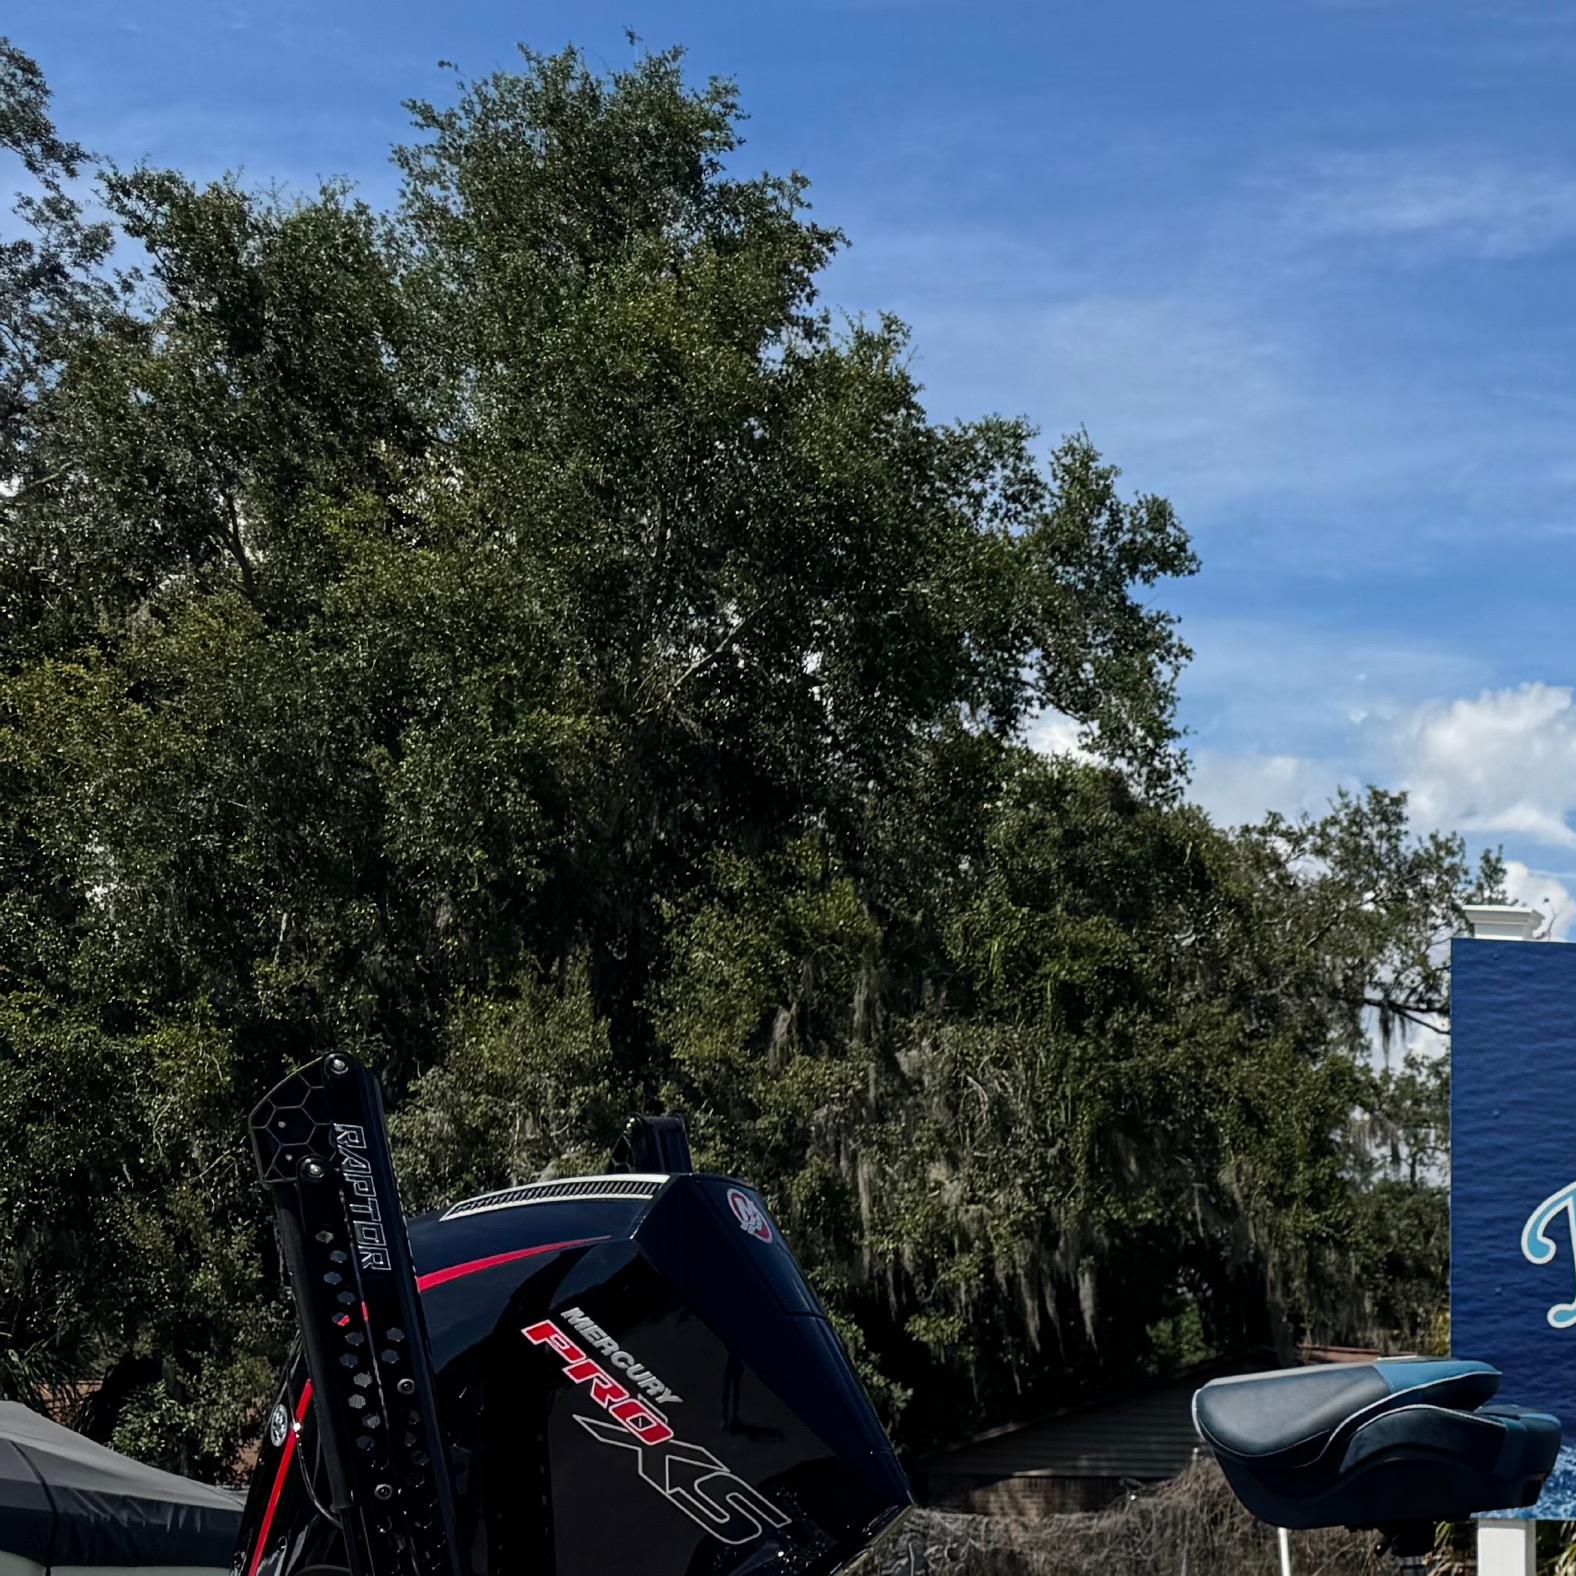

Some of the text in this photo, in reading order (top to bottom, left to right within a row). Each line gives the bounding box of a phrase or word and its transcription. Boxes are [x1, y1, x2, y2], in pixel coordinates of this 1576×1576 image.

[334, 1122, 392, 1272] RAPTOR
[521, 1320, 675, 1446] PRO
[561, 1306, 683, 1404] MERCURY
[572, 1414, 792, 1545] XS
